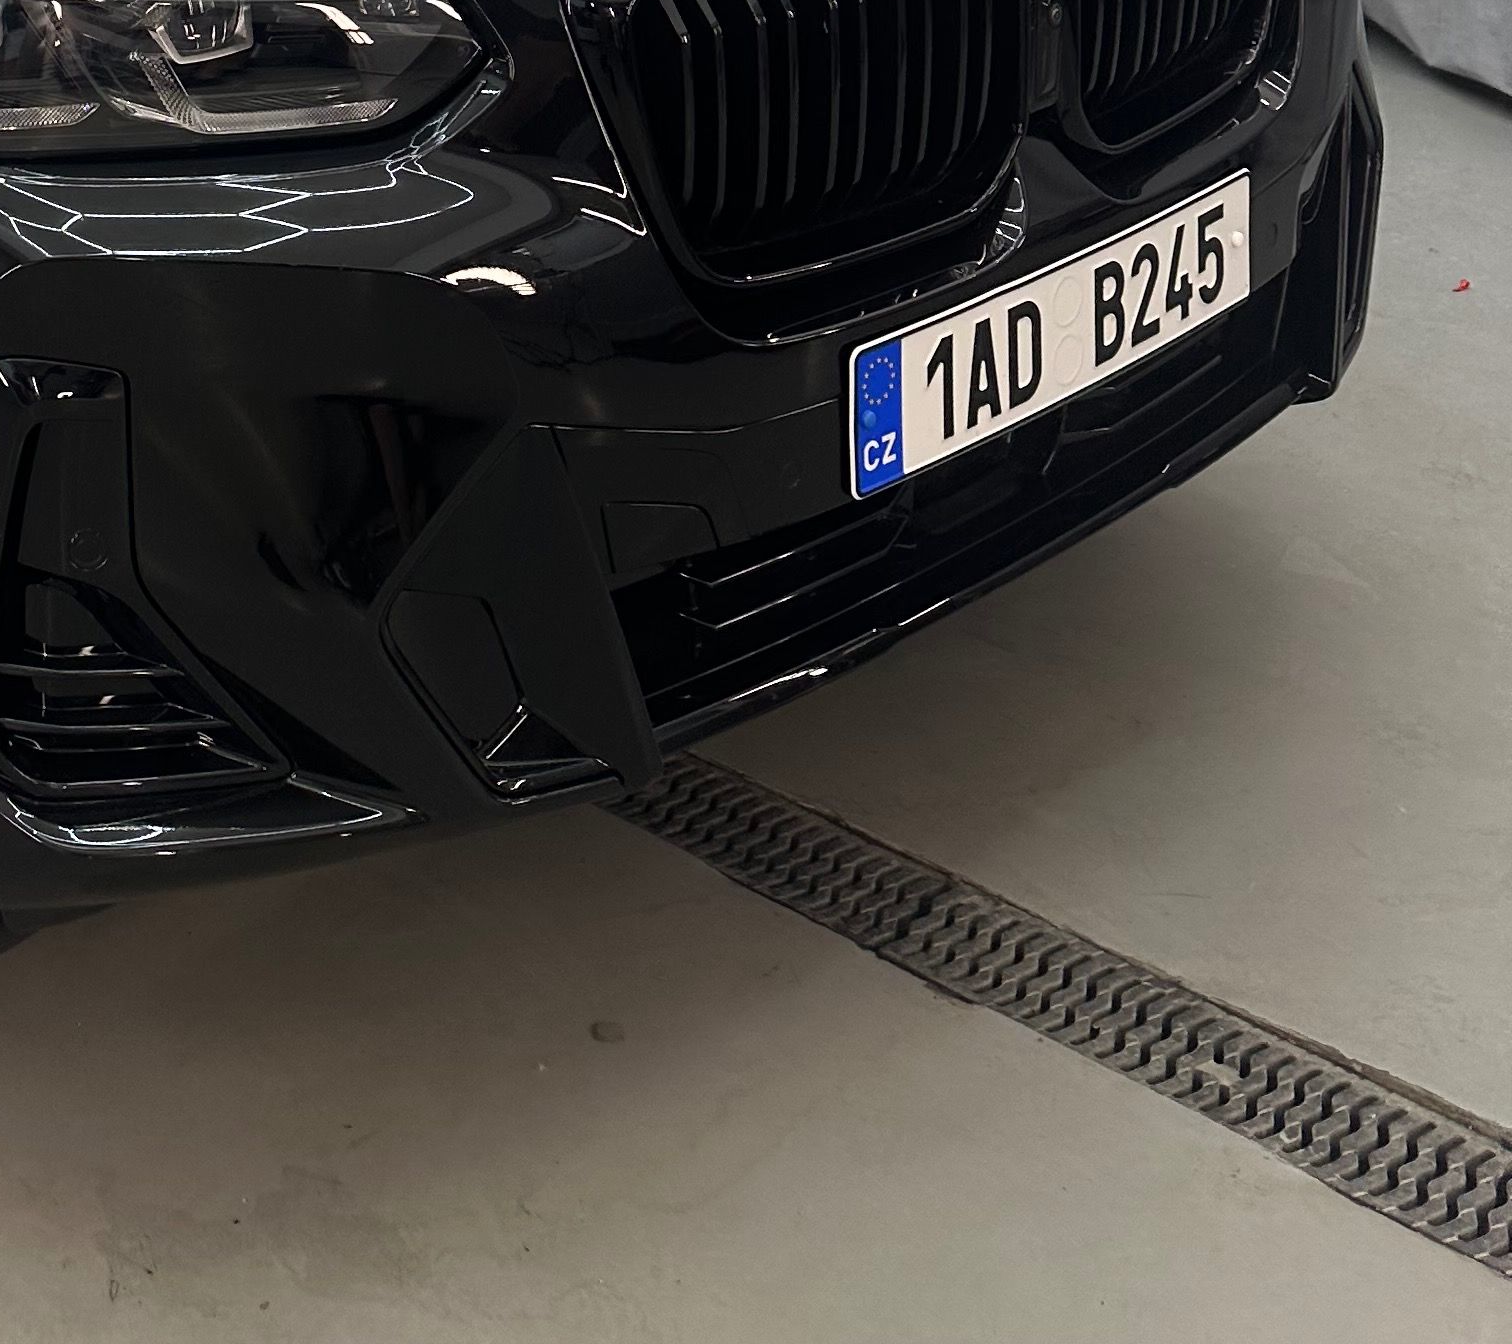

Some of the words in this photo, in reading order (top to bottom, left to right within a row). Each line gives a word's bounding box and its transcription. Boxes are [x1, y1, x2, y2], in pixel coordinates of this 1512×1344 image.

[927, 300, 1042, 440] 1AD
[1094, 203, 1224, 368] B245
[864, 431, 897, 472] CZ
